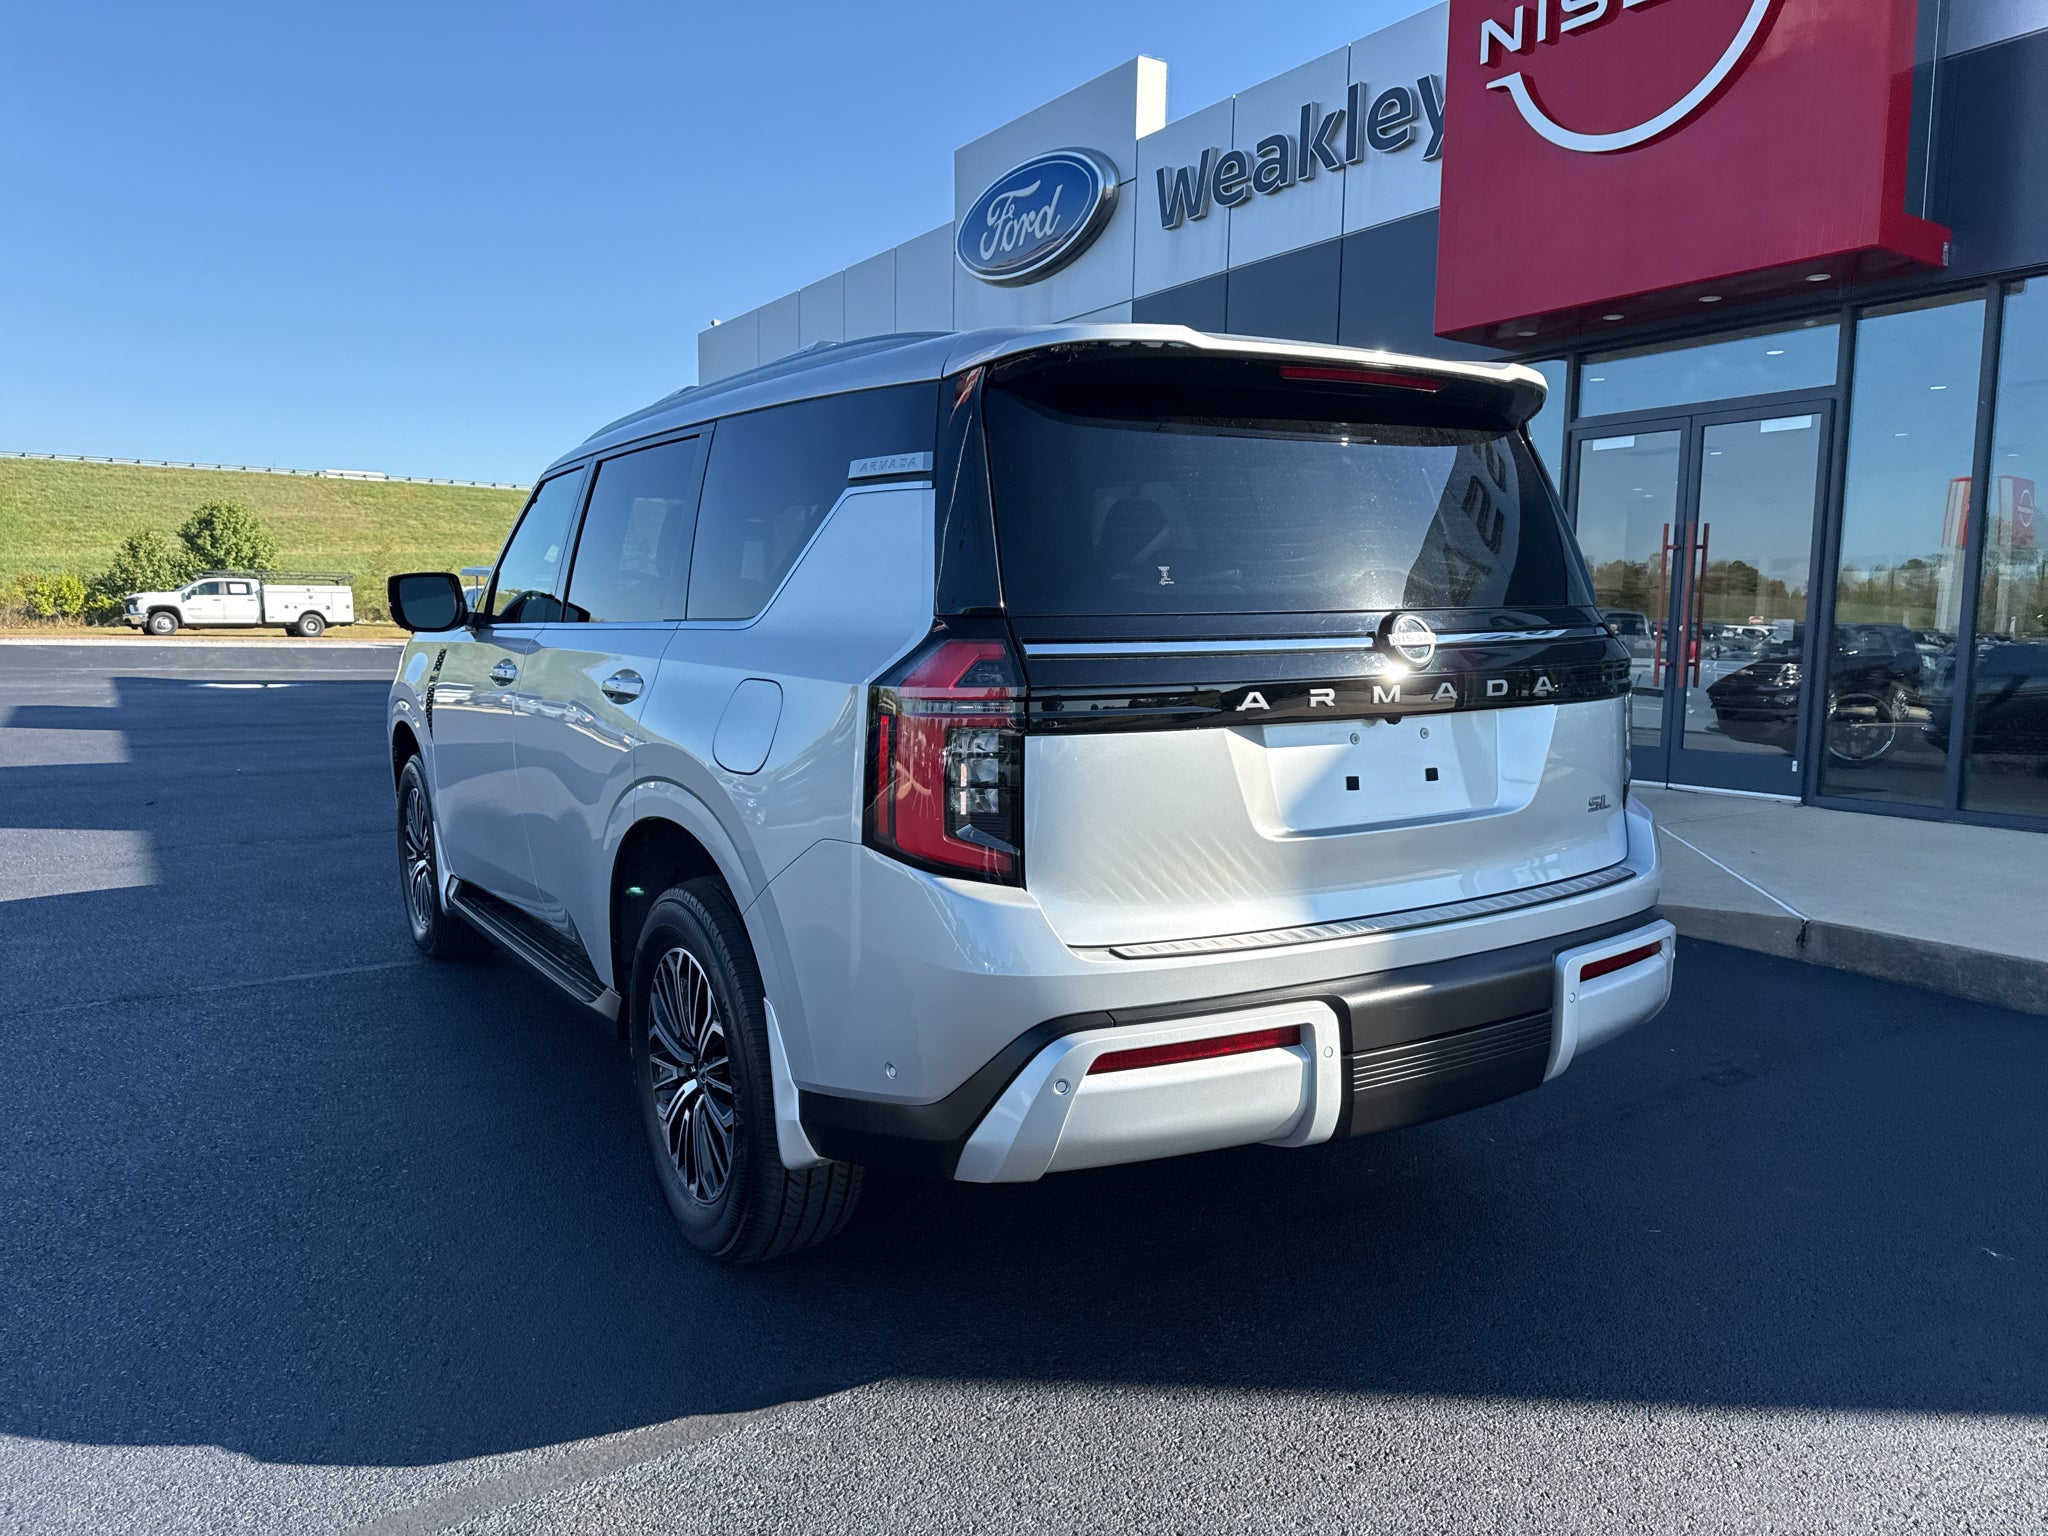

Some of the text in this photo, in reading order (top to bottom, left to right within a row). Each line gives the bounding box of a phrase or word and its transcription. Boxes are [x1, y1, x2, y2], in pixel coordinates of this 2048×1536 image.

[1480, 0, 1648, 65] NIS
[1156, 73, 1444, 230] Weakley
[979, 179, 1064, 261] Ford
[1235, 675, 1555, 712] ARMADA
[1587, 794, 1611, 812] SL
